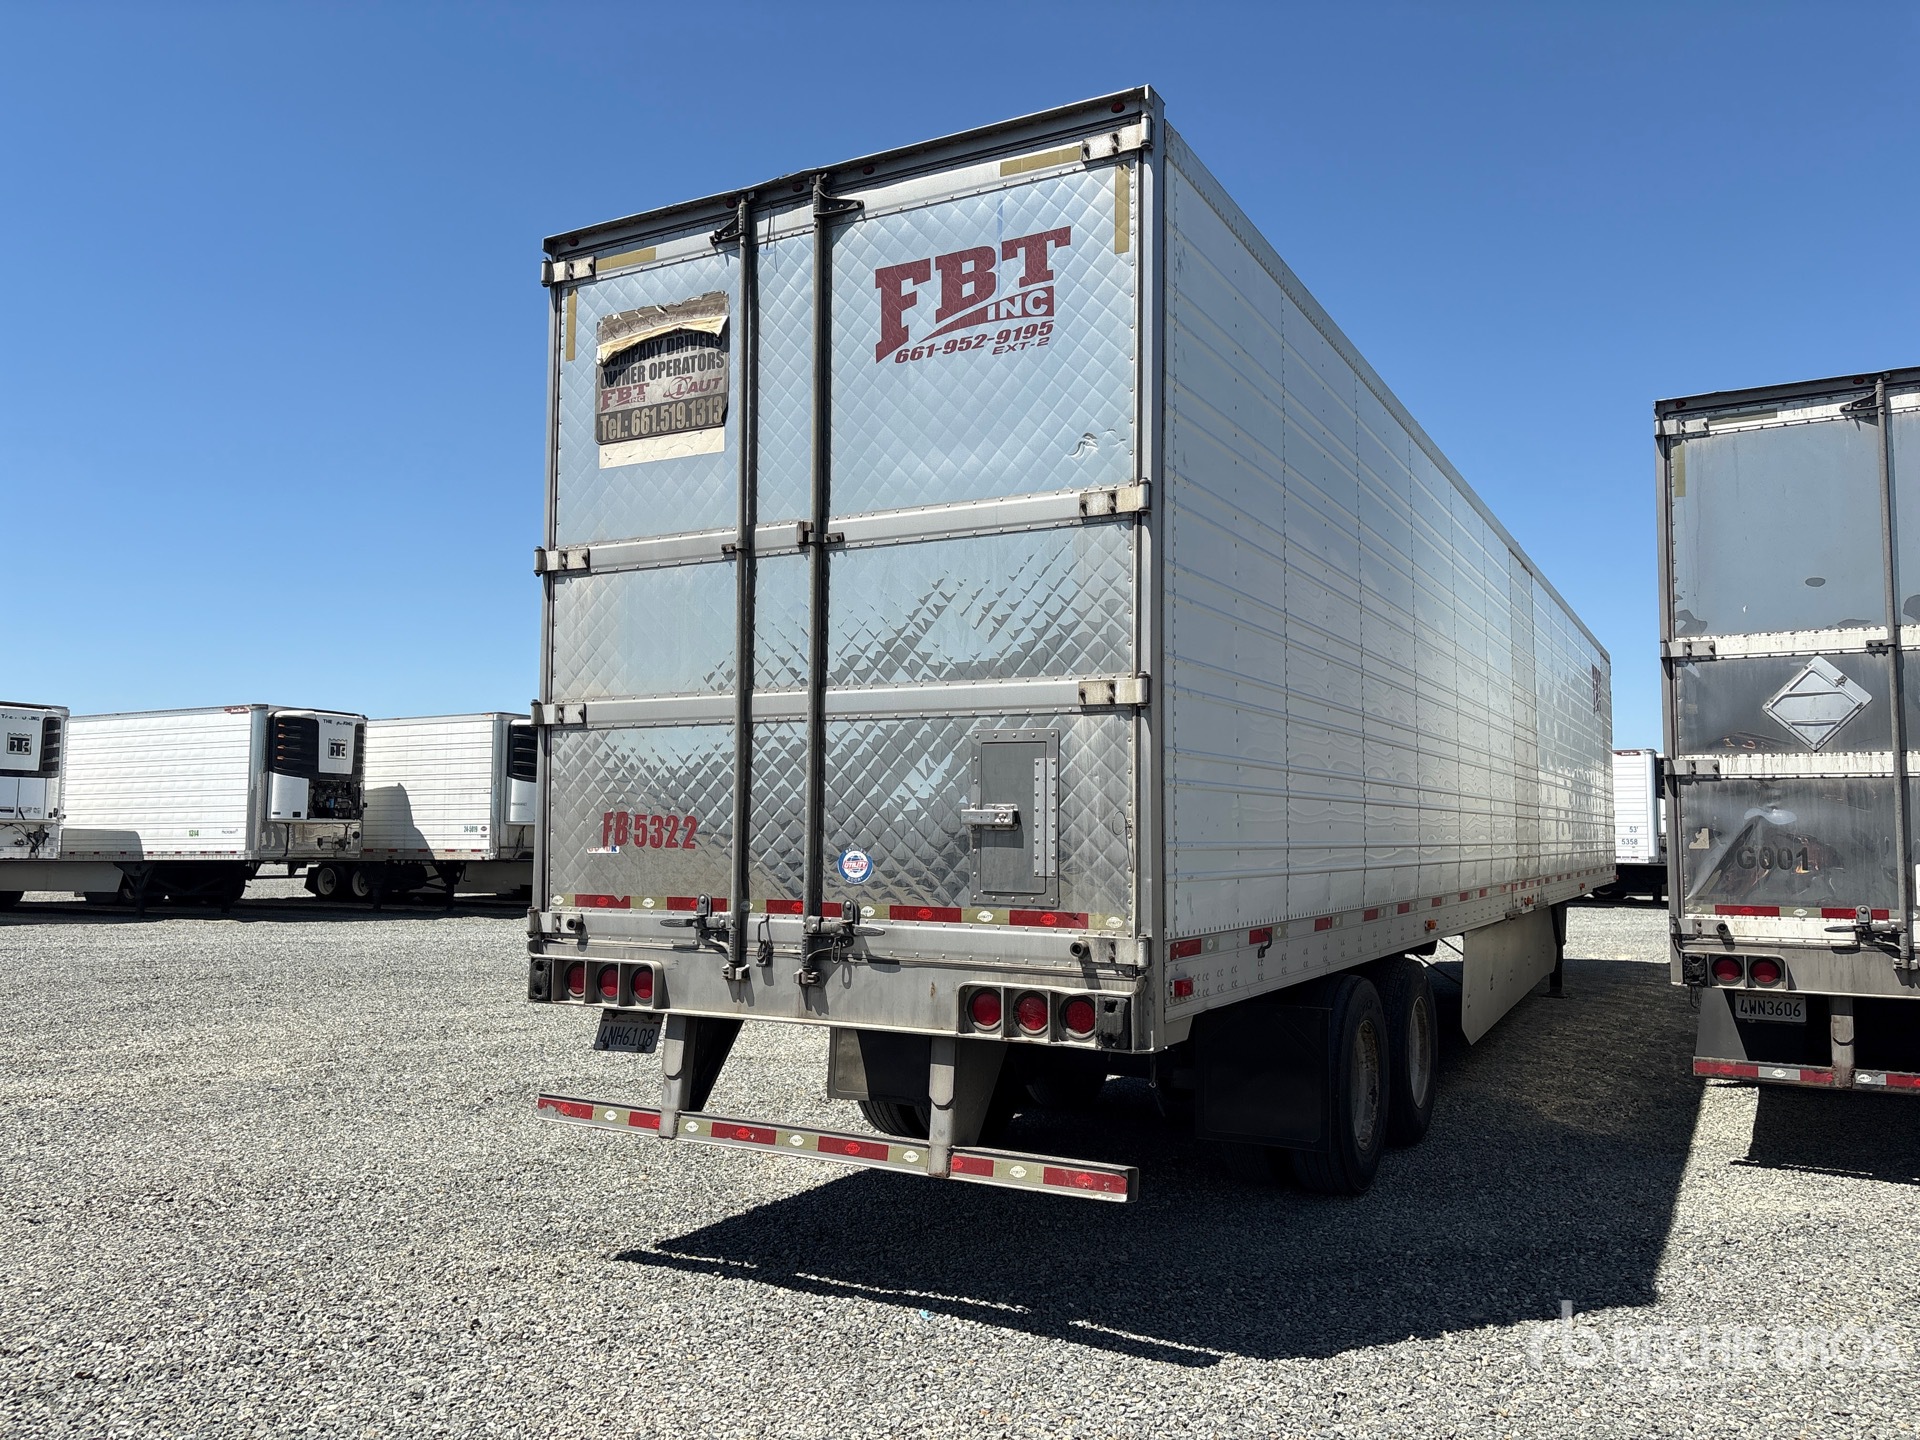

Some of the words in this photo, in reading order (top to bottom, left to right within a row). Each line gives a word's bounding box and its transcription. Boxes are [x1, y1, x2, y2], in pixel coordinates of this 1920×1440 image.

[875, 225, 1071, 364] FBT
[987, 289, 1049, 321] INC
[894, 320, 1055, 364] 661-952-9195
[992, 336, 1050, 356] EXT-2
[600, 364, 646, 390] OWNER
[649, 350, 725, 380] OPERATORS
[600, 382, 650, 413] FBT
[601, 412, 629, 441] Tel.:
[631, 395, 723, 437] 661.519.1313
[1621, 838, 1638, 846] 5358
[1736, 846, 1809, 871] G001
[1740, 999, 1802, 1018] 4WN3606
[600, 1025, 656, 1047] 4NH6108
